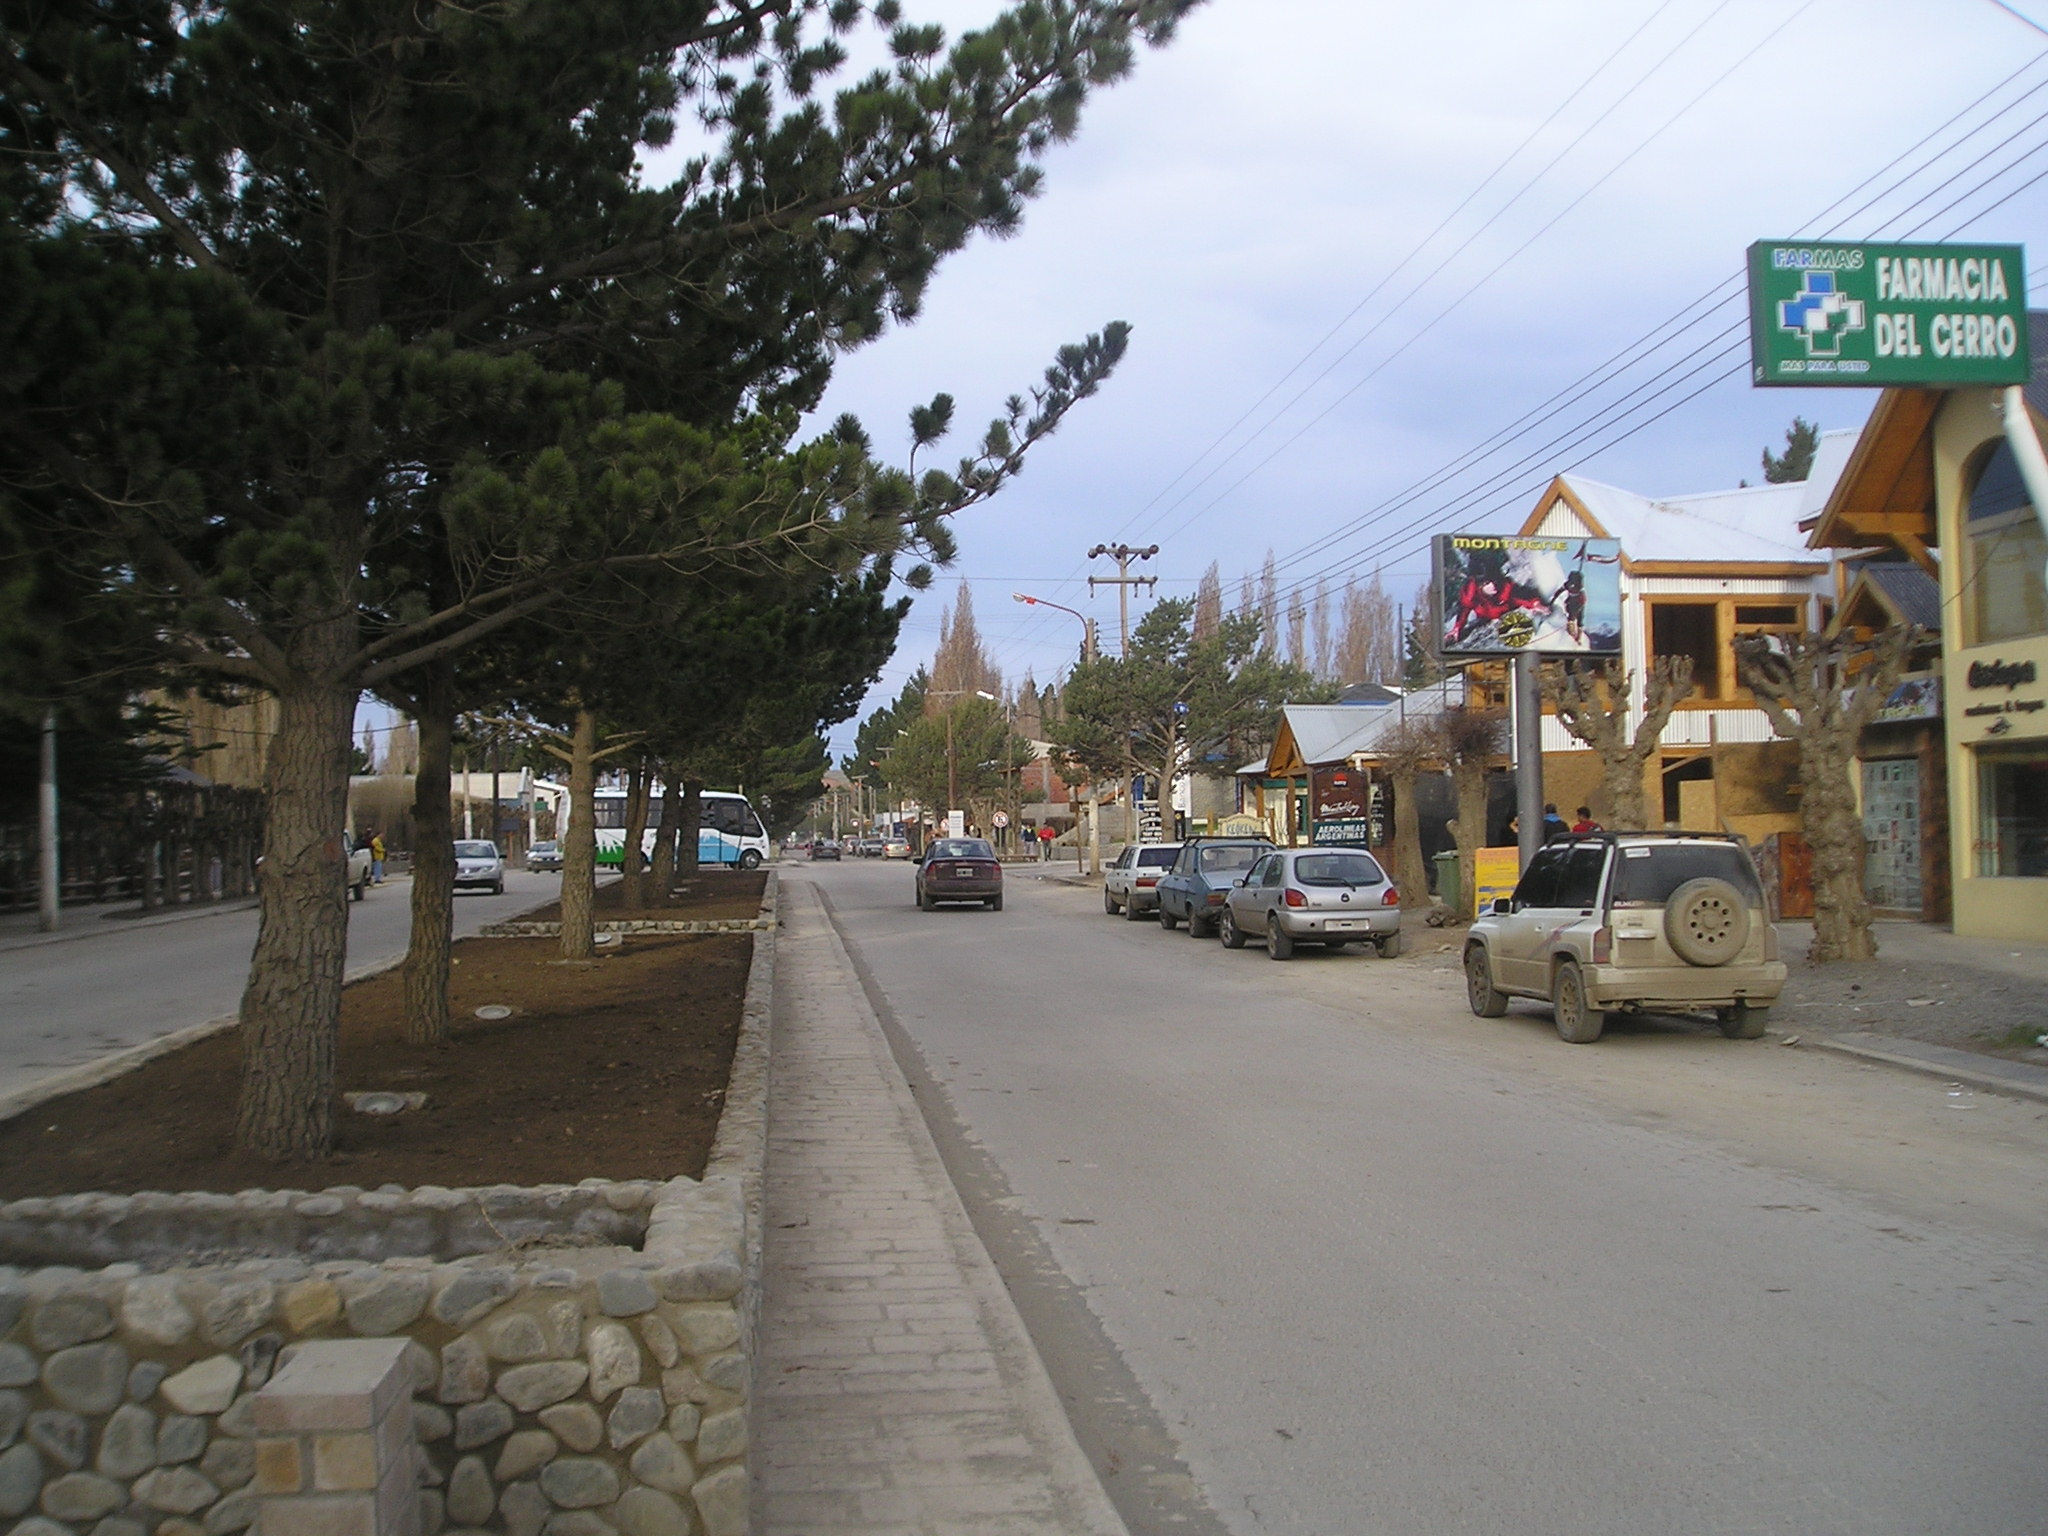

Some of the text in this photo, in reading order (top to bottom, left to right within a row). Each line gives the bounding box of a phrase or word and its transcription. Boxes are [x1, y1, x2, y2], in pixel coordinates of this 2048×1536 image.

[1774, 248, 1864, 269] FARMAS
[1875, 256, 2009, 301] FARMACIA
[1875, 313, 2018, 358] DEL CERRO
[1315, 831, 1365, 841] ARGENTINAS
[1318, 824, 1367, 834] AEROLINEAS
